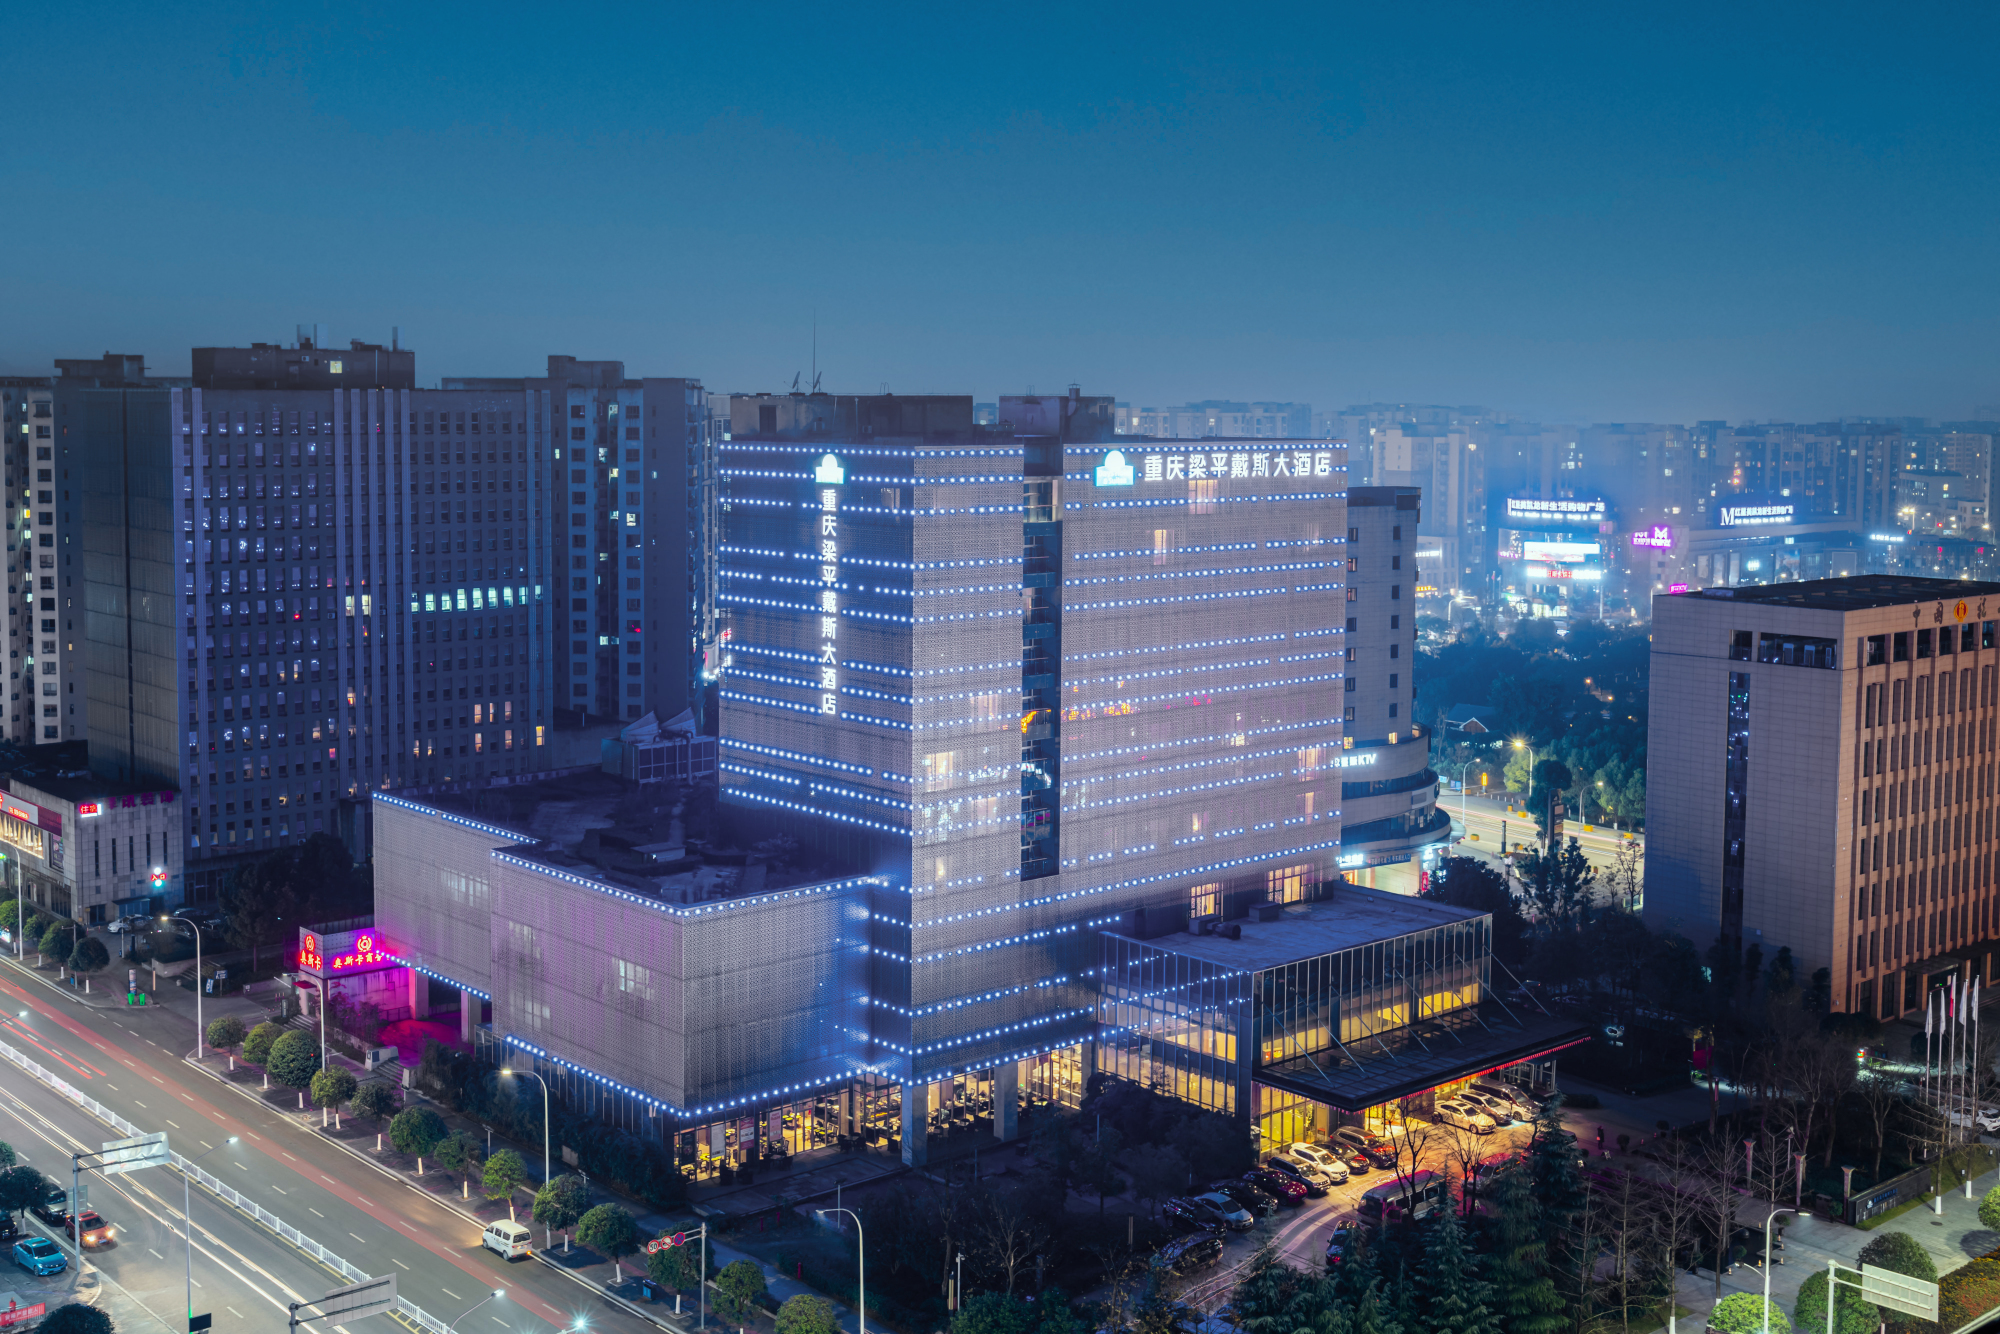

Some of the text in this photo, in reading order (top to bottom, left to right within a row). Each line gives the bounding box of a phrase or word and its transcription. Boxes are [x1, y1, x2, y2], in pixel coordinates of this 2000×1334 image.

[1144, 452, 1332, 480] 重庆梁平戴斯大酒店
[822, 489, 837, 715] 重庆梁平戴斯大酒店
[151, 873, 167, 882] 入口
[300, 949, 322, 971] 奥斯卡
[649, 1243, 657, 1251] 50
